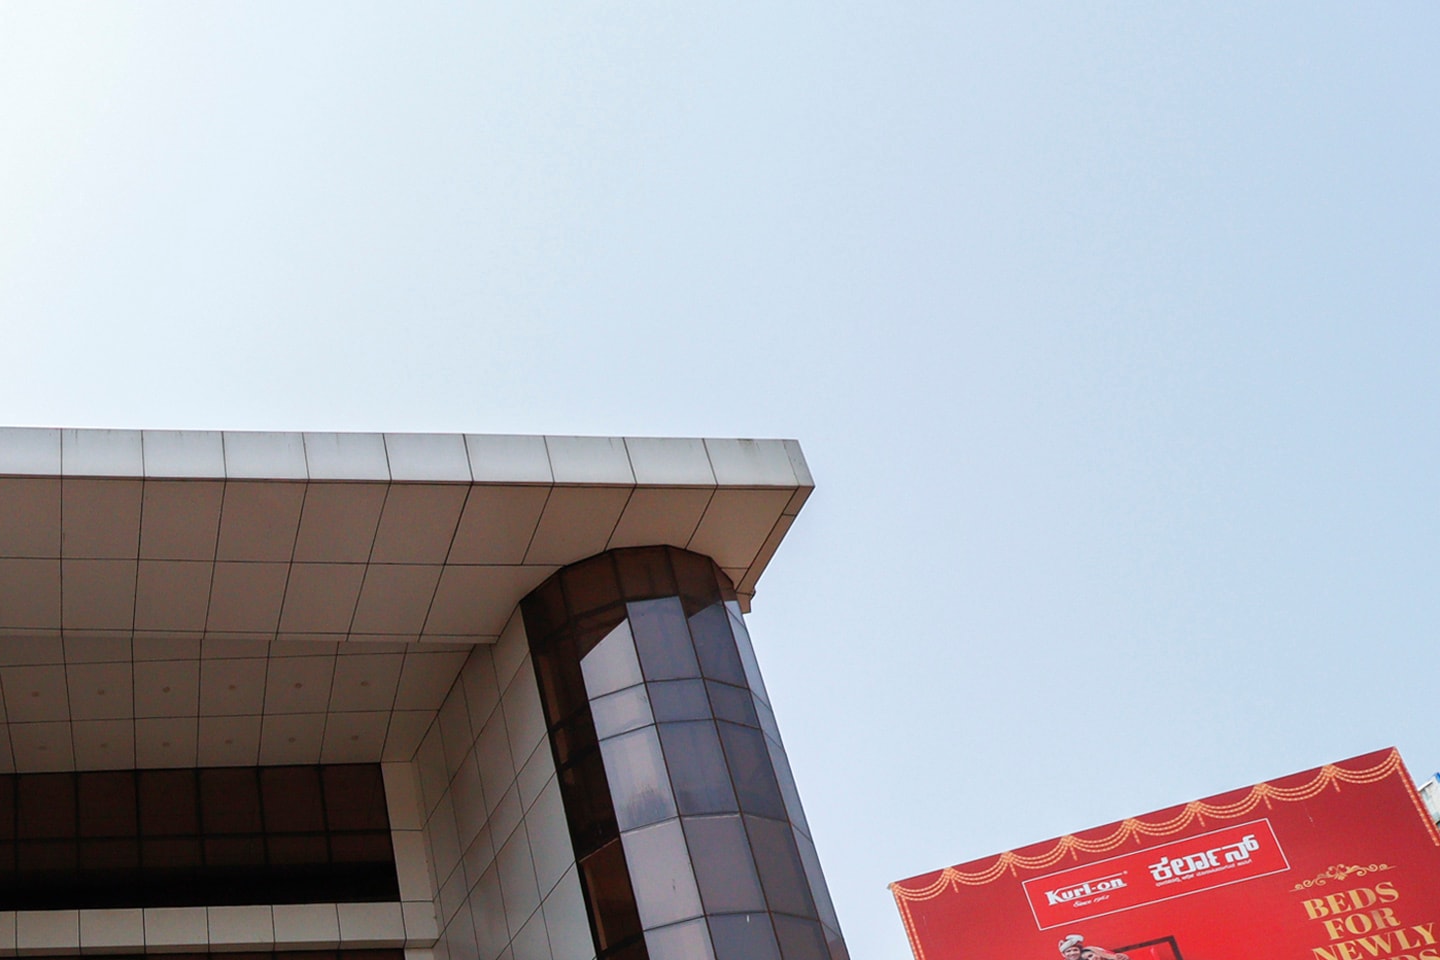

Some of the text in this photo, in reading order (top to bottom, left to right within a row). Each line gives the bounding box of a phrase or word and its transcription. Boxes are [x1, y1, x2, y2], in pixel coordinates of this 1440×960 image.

[1044, 874, 1128, 906] Kurl-on
[1301, 881, 1400, 920] BEDS
[1323, 907, 1401, 940] FOR
